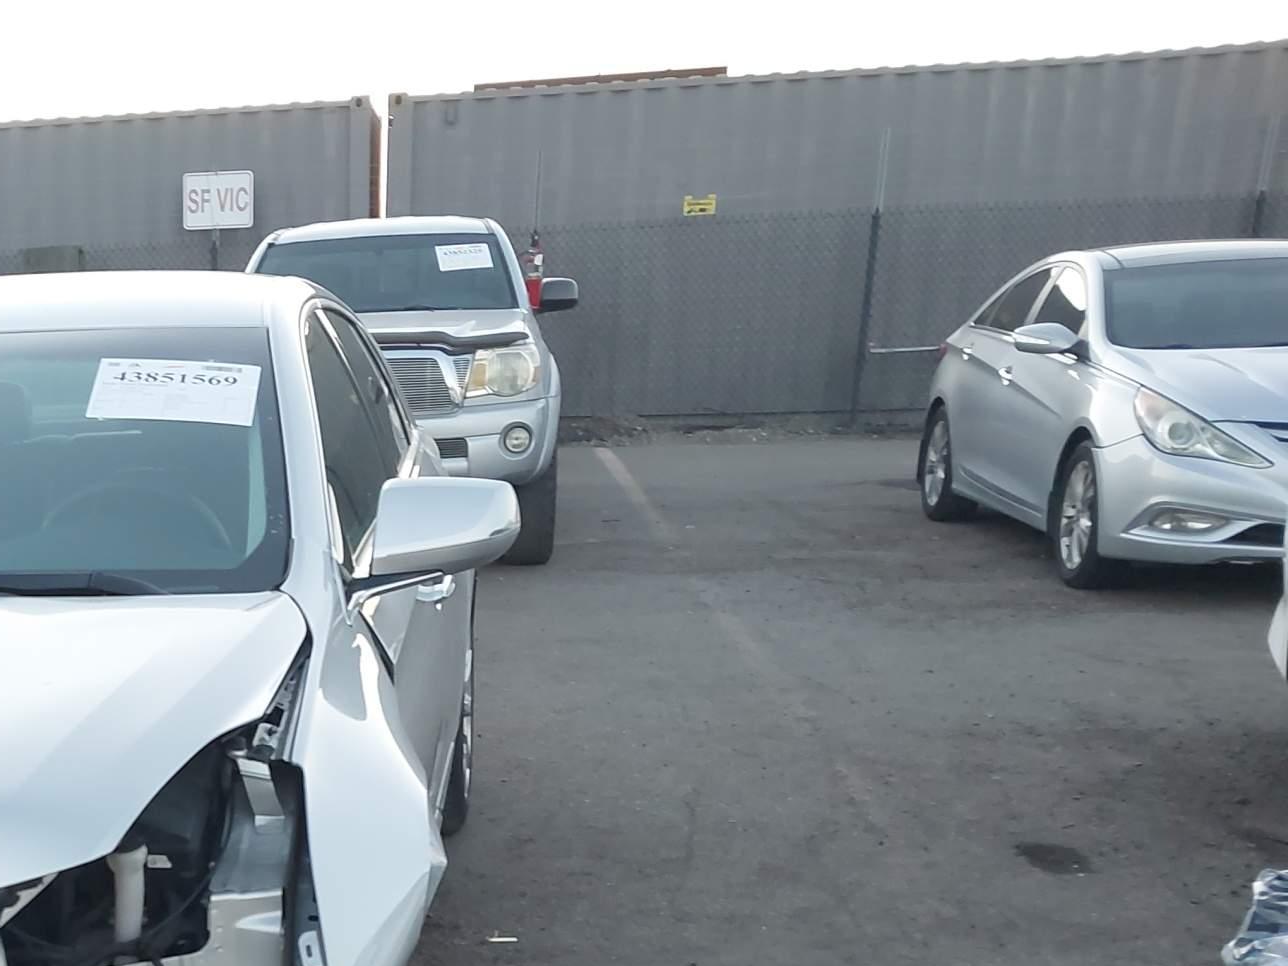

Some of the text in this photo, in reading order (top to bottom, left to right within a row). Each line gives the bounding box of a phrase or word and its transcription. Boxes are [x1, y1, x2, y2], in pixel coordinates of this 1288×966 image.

[188, 186, 248, 214] SF VIC
[113, 371, 238, 386] 43851569
